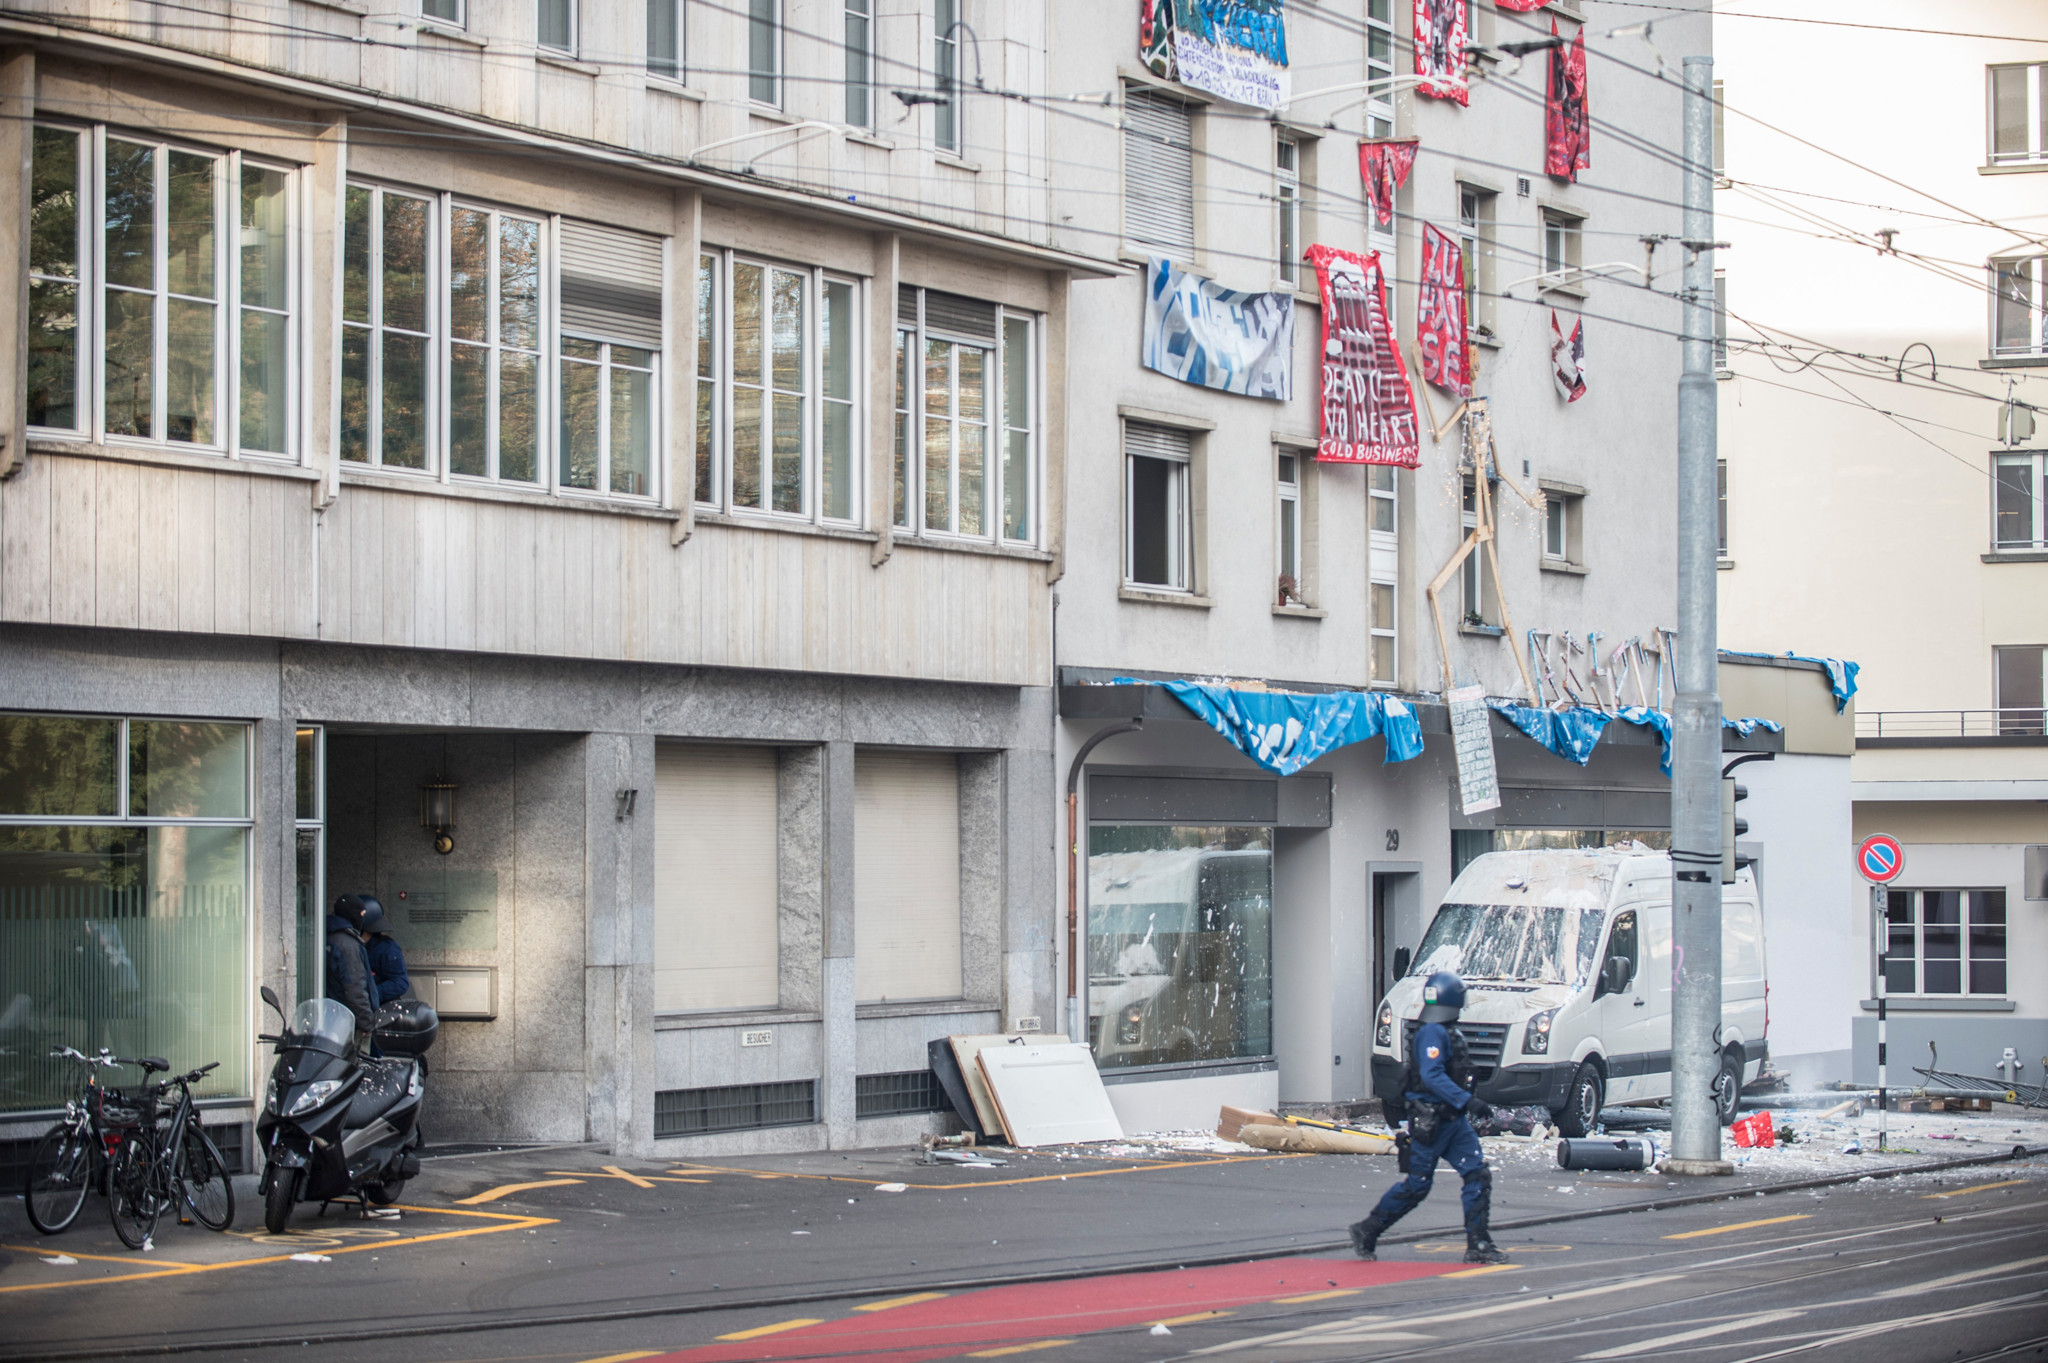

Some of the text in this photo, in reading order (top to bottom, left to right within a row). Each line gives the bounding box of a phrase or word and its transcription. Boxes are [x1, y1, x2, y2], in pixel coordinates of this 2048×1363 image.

[1323, 365, 1366, 404] DEAD
[1357, 410, 1416, 446] HEART
[1320, 438, 1418, 463] COLD BUSINESS
[1386, 829, 1399, 852] 29
